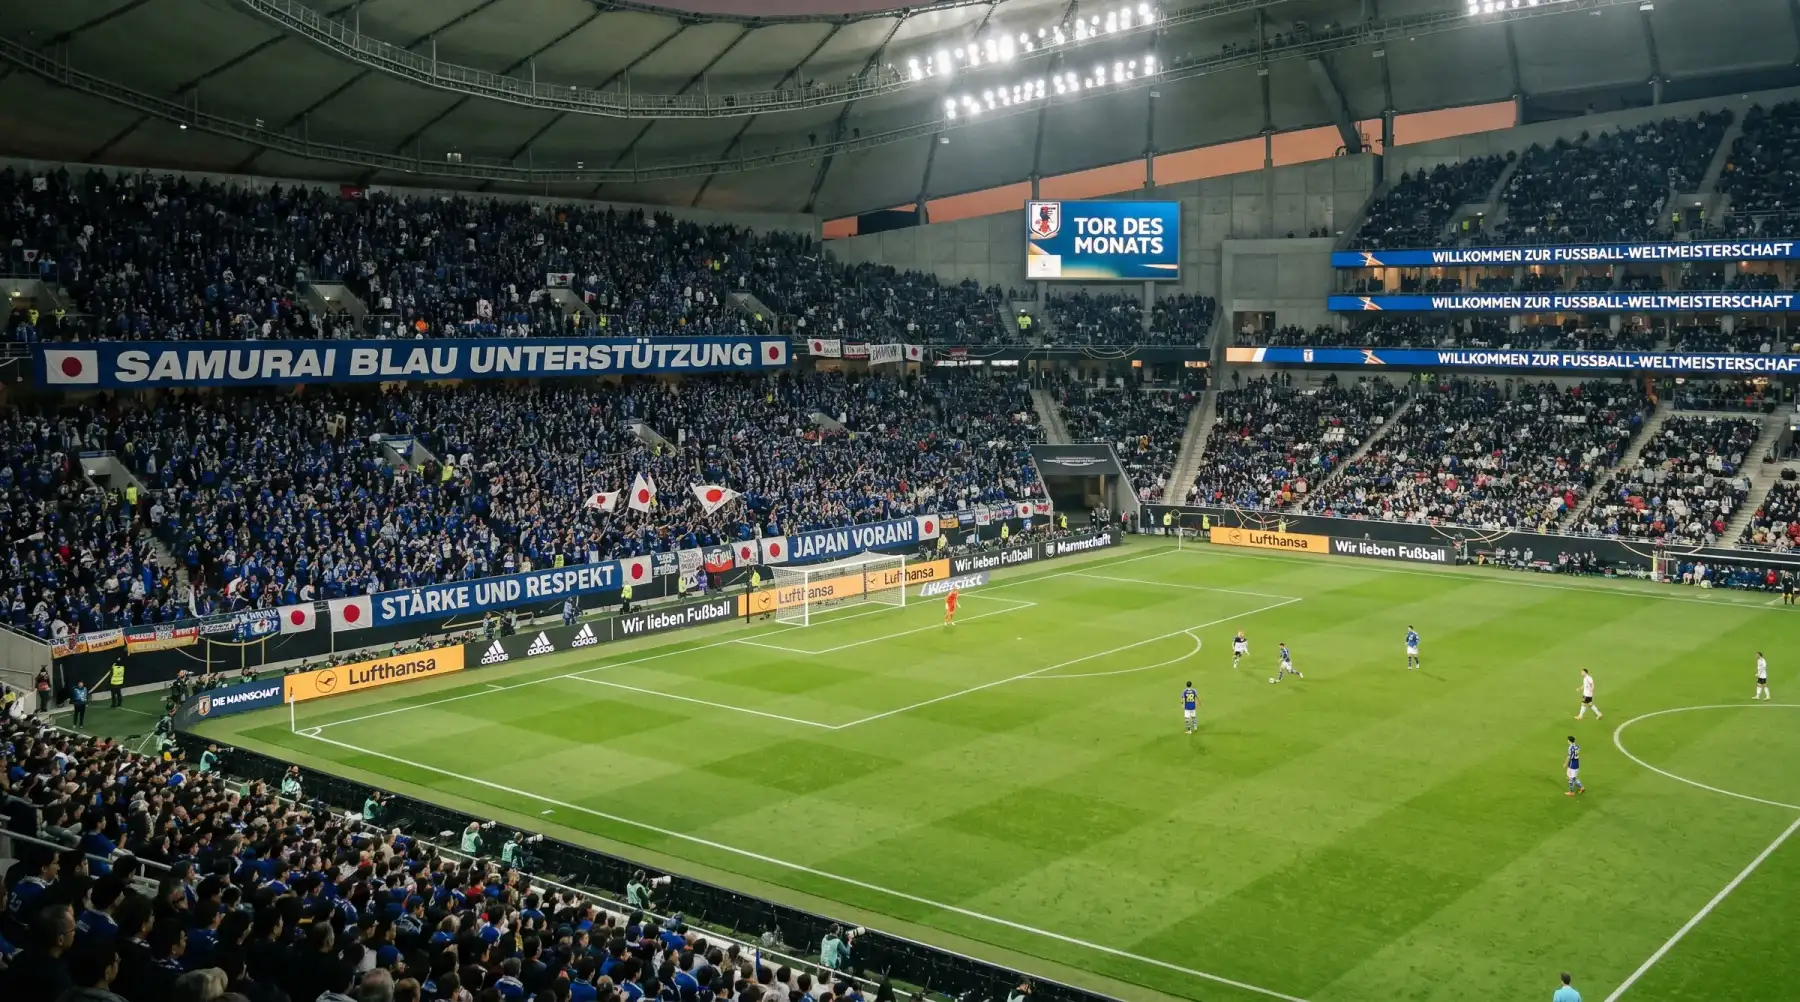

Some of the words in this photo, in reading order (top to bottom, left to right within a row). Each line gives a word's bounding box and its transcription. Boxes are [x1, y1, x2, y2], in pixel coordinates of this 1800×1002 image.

[1073, 217, 1117, 235] TOR
[1123, 217, 1163, 235] DES
[1074, 236, 1164, 254] MONATS
[1432, 249, 1521, 263] WILLKOMMEN
[1524, 249, 1551, 261] ZUR
[1554, 242, 1794, 261] FUSSBALL-WELTMEISTERSCHAFT
[1431, 296, 1521, 309] WILLKOMMEN
[1524, 296, 1551, 309] ZUR
[1554, 295, 1794, 309] FUSSBALL-WELTMEISTERSCHAFT
[114, 347, 337, 384] SAMURAI
[349, 347, 459, 377] BLAU
[469, 337, 753, 373] UNTERSTÜTZUNG
[1437, 352, 1529, 366] WILLKOMMEN
[1531, 354, 1560, 366] ZUR
[1562, 355, 1800, 371] FUSSBALL-WELTMEISTERSCHAF
[793, 530, 850, 558] JAPAN
[851, 521, 913, 549] VORAN!
[1249, 532, 1308, 549] Lufthansa
[1335, 539, 1357, 553] Wir
[1359, 542, 1396, 557] lieben
[1398, 545, 1445, 562] Fußball
[954, 558, 973, 573] Wir
[973, 555, 1000, 569] lieben
[1001, 547, 1033, 565] Fußball
[380, 588, 470, 620] STÄRKE
[475, 579, 521, 606] UND
[526, 565, 615, 598] RESPEKT
[621, 616, 645, 634] Wir
[647, 611, 685, 630] lieben
[687, 600, 730, 623] Fußball
[348, 656, 436, 686] Lufthansa
[212, 696, 226, 707] DIE
[227, 686, 280, 704] MANNSCHAFT
